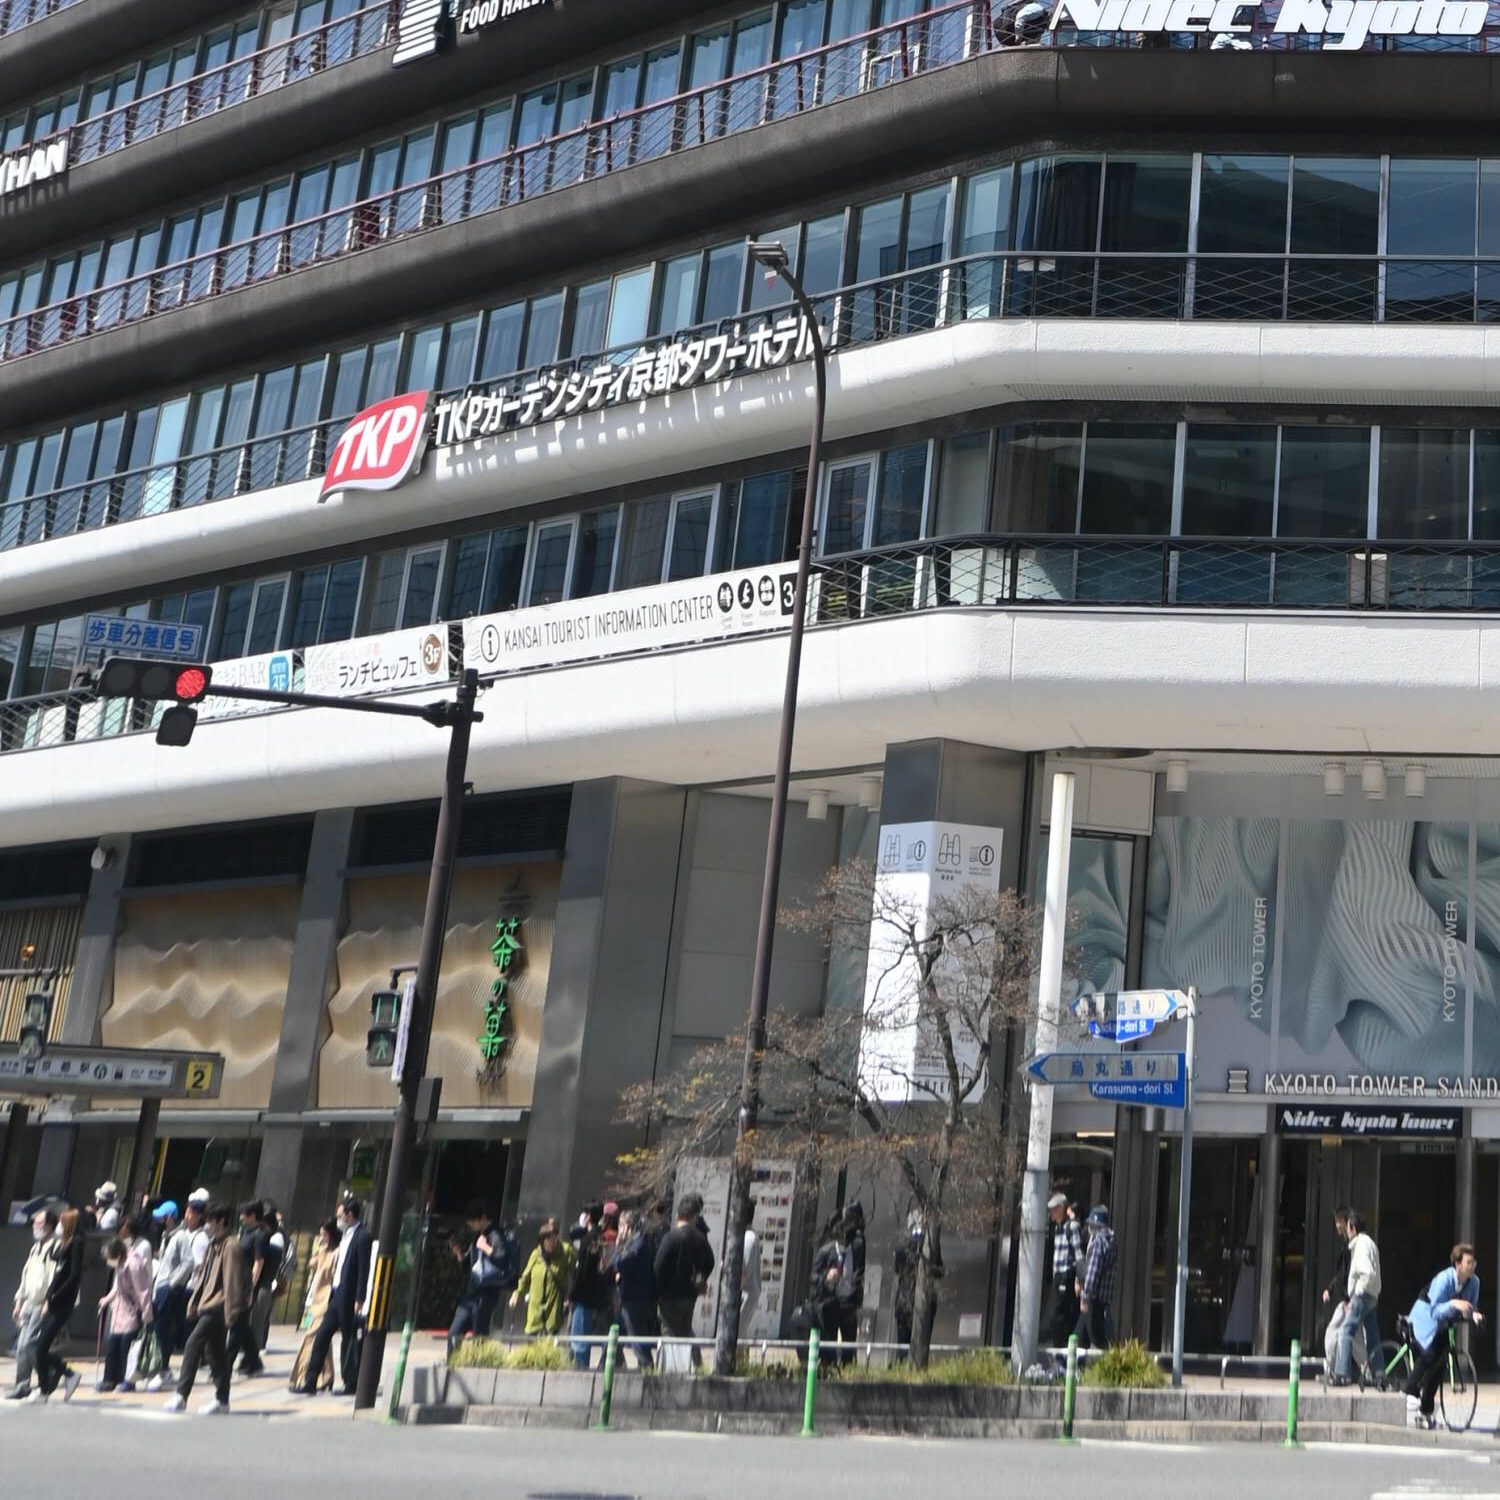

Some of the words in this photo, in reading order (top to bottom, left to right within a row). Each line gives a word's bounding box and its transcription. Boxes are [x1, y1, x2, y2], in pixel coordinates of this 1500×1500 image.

[459, 2, 499, 33] FOOD
[332, 405, 418, 478] TKP
[88, 618, 198, 652] 歩車分離信号
[504, 626, 541, 652] KANSAI
[544, 615, 591, 646] TOURIST
[594, 603, 669, 640] INFORMATION
[671, 595, 714, 624] CENTER
[424, 643, 441, 664] 3F
[1253, 896, 1268, 957] TOWER
[1445, 899, 1459, 961] TOWER
[1249, 961, 1264, 1019] KYOTO
[1442, 964, 1457, 1022] KYOTO
[191, 1069, 205, 1089] 2
[1070, 1059, 1157, 1077] 烏丸通り
[1265, 1073, 1336, 1096] KYOTO
[1348, 1074, 1426, 1098] TOWER
[1281, 1109, 1337, 1127] Nidec
[1341, 1111, 1398, 1132] Kyoto
[1401, 1112, 1459, 1130] Tower
